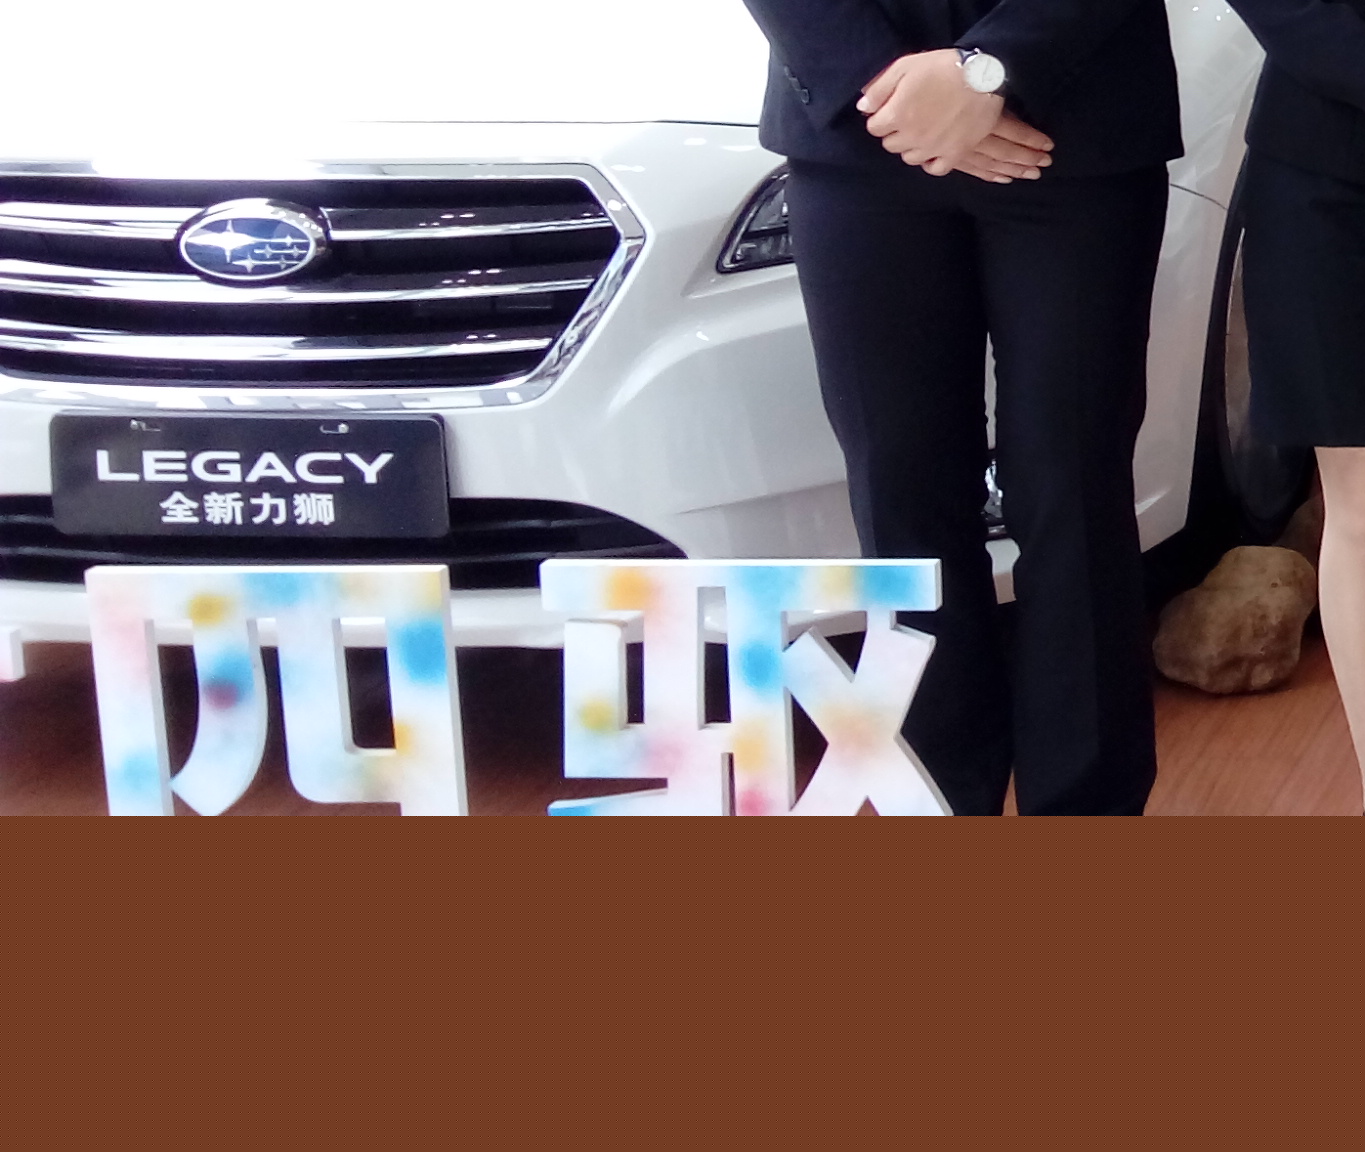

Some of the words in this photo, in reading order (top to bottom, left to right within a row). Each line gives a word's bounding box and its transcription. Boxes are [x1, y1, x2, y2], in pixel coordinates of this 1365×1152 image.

[95, 449, 394, 484] LEGACY
[160, 491, 336, 526] 全新力狮
